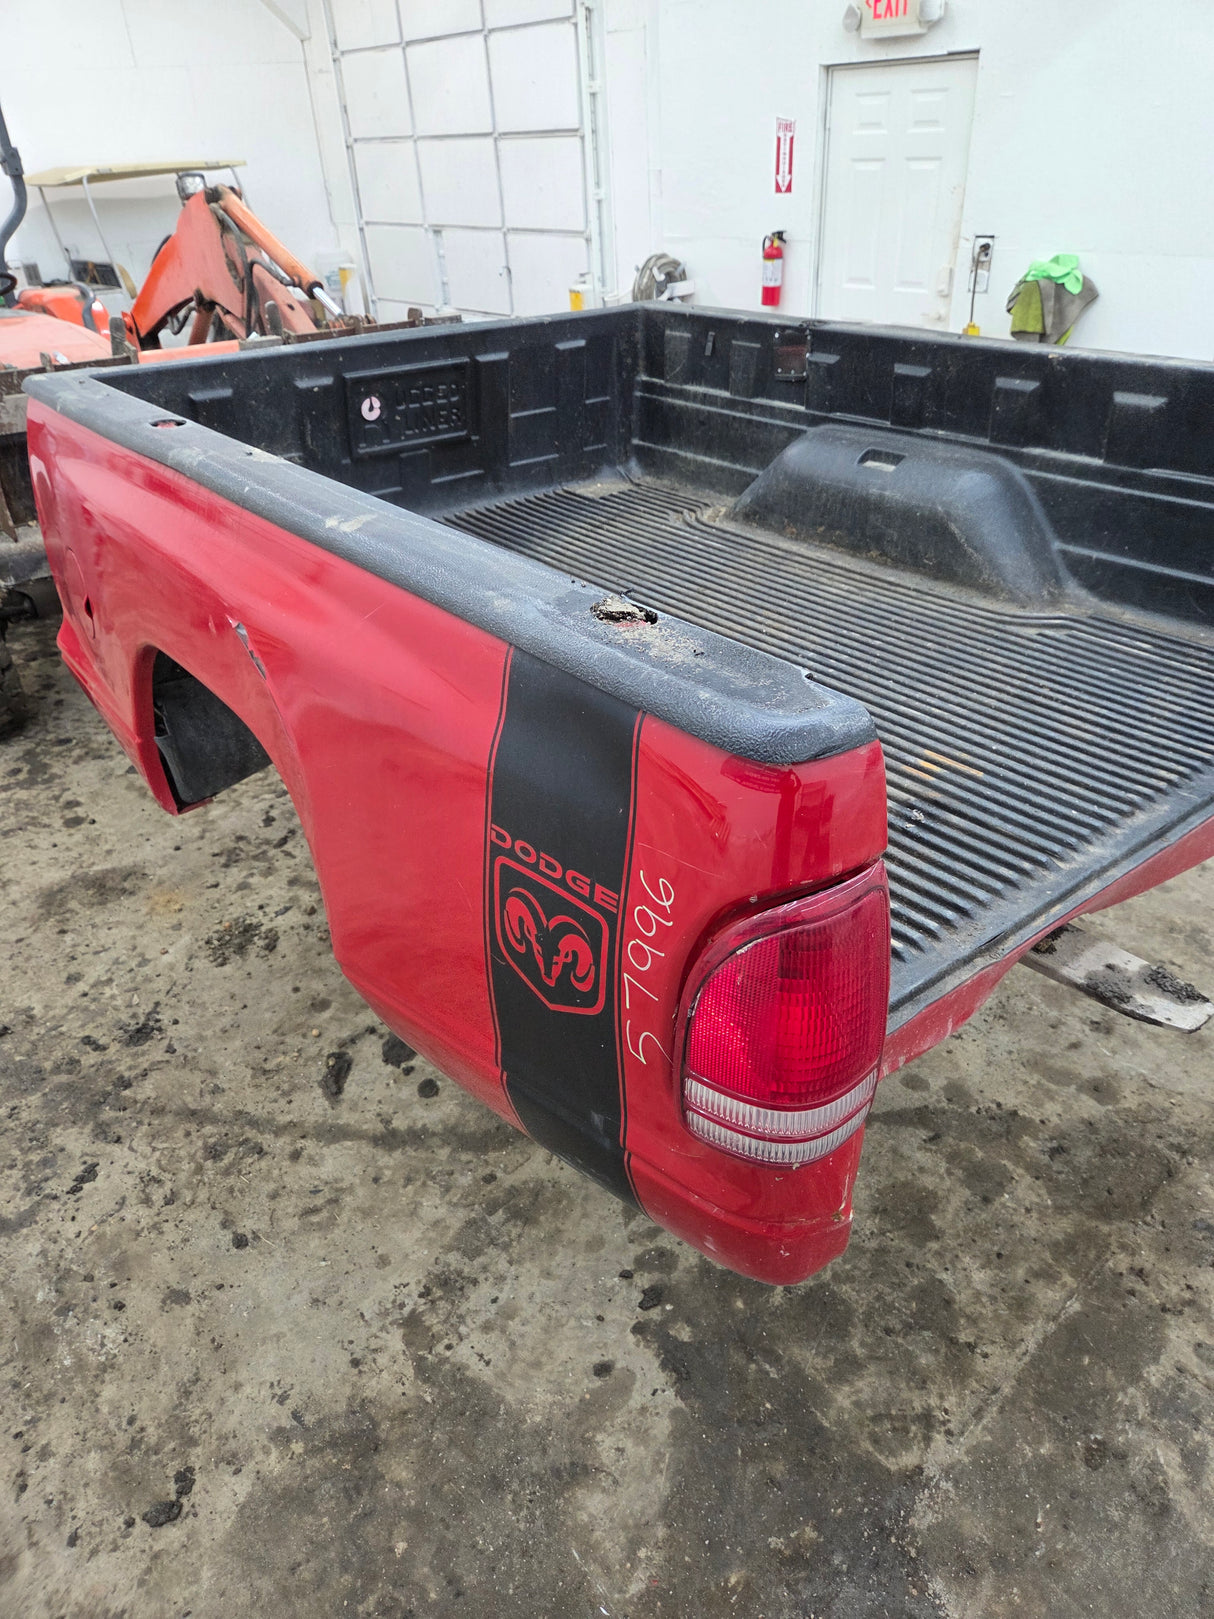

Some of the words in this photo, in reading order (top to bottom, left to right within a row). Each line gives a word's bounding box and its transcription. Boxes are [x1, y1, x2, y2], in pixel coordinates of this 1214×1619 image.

[778, 122, 793, 133] FIRE
[490, 823, 619, 914] DODGE
[623, 869, 675, 1065] 57996
